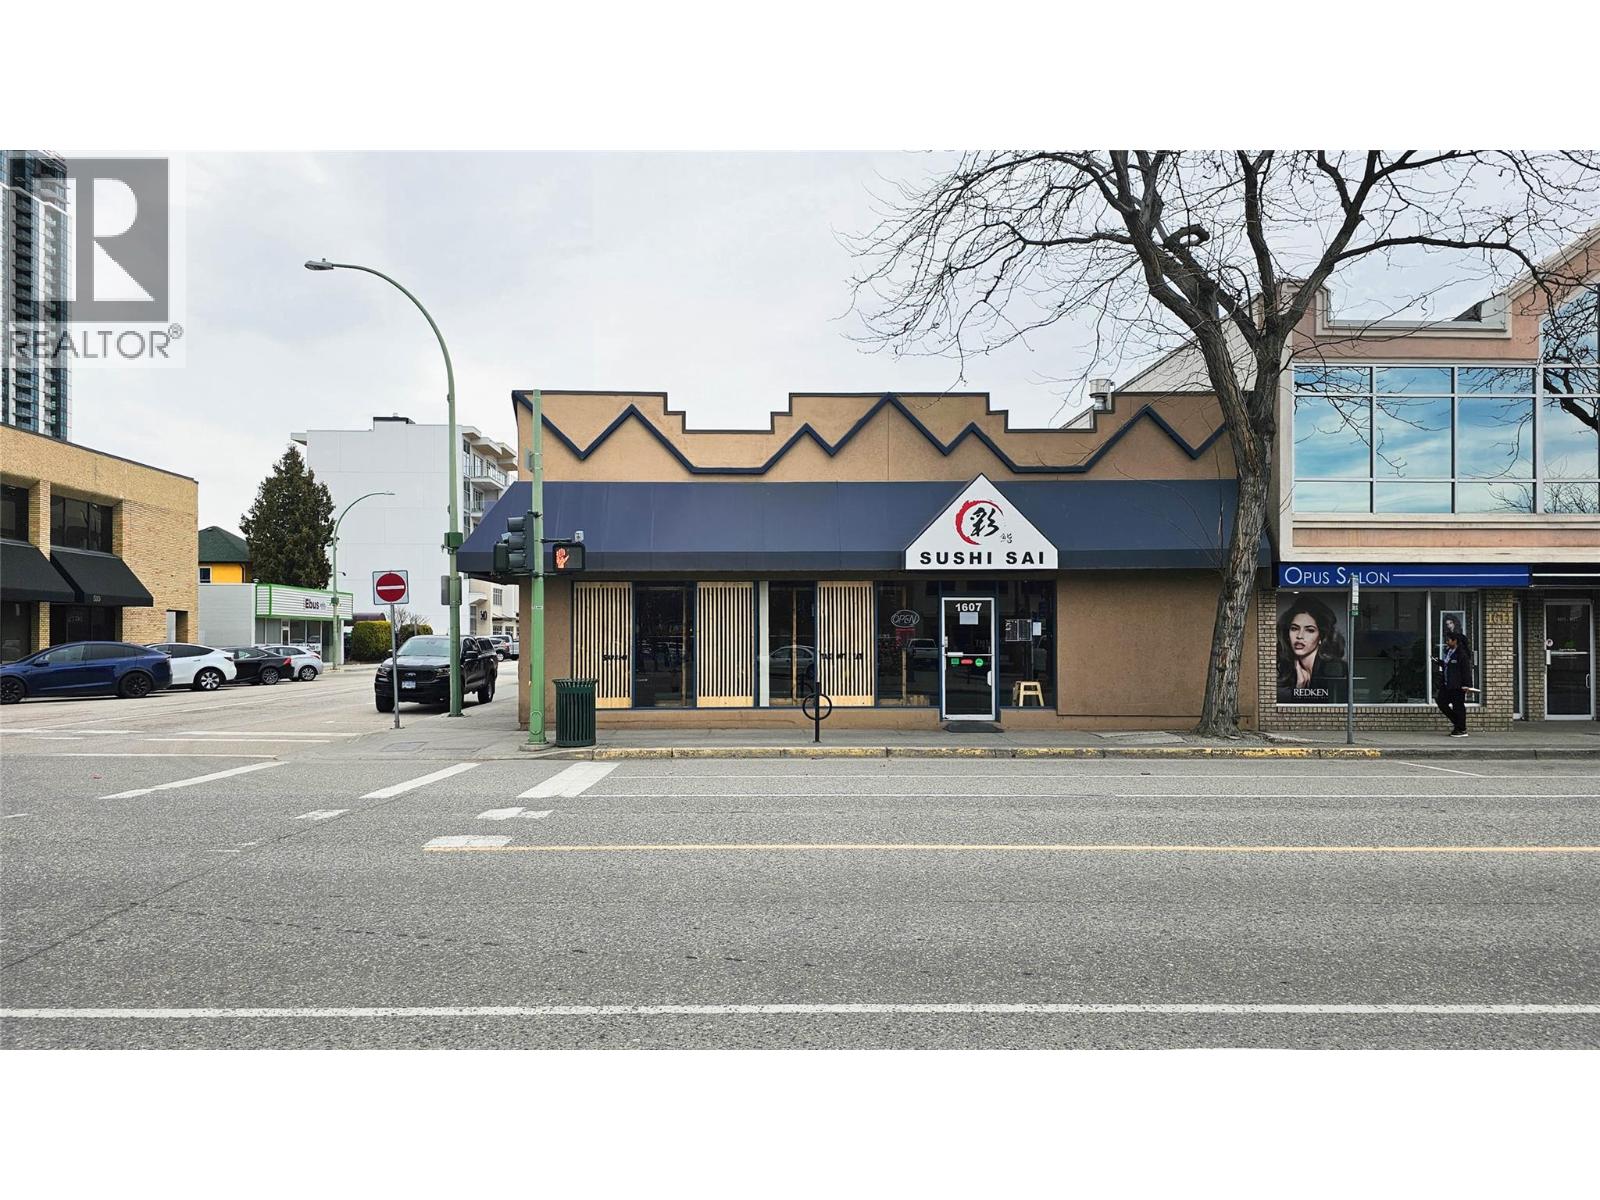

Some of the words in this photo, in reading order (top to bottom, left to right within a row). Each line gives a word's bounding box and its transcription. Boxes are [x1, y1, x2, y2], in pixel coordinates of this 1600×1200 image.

[970, 507, 999, 537] 彩
[920, 551, 992, 565] SUSHI
[1005, 551, 1044, 565] SAI
[304, 598, 320, 610] Ebus
[955, 602, 983, 612] 1607
[893, 614, 918, 625] OPEN
[1293, 688, 1329, 697] REDKEN
